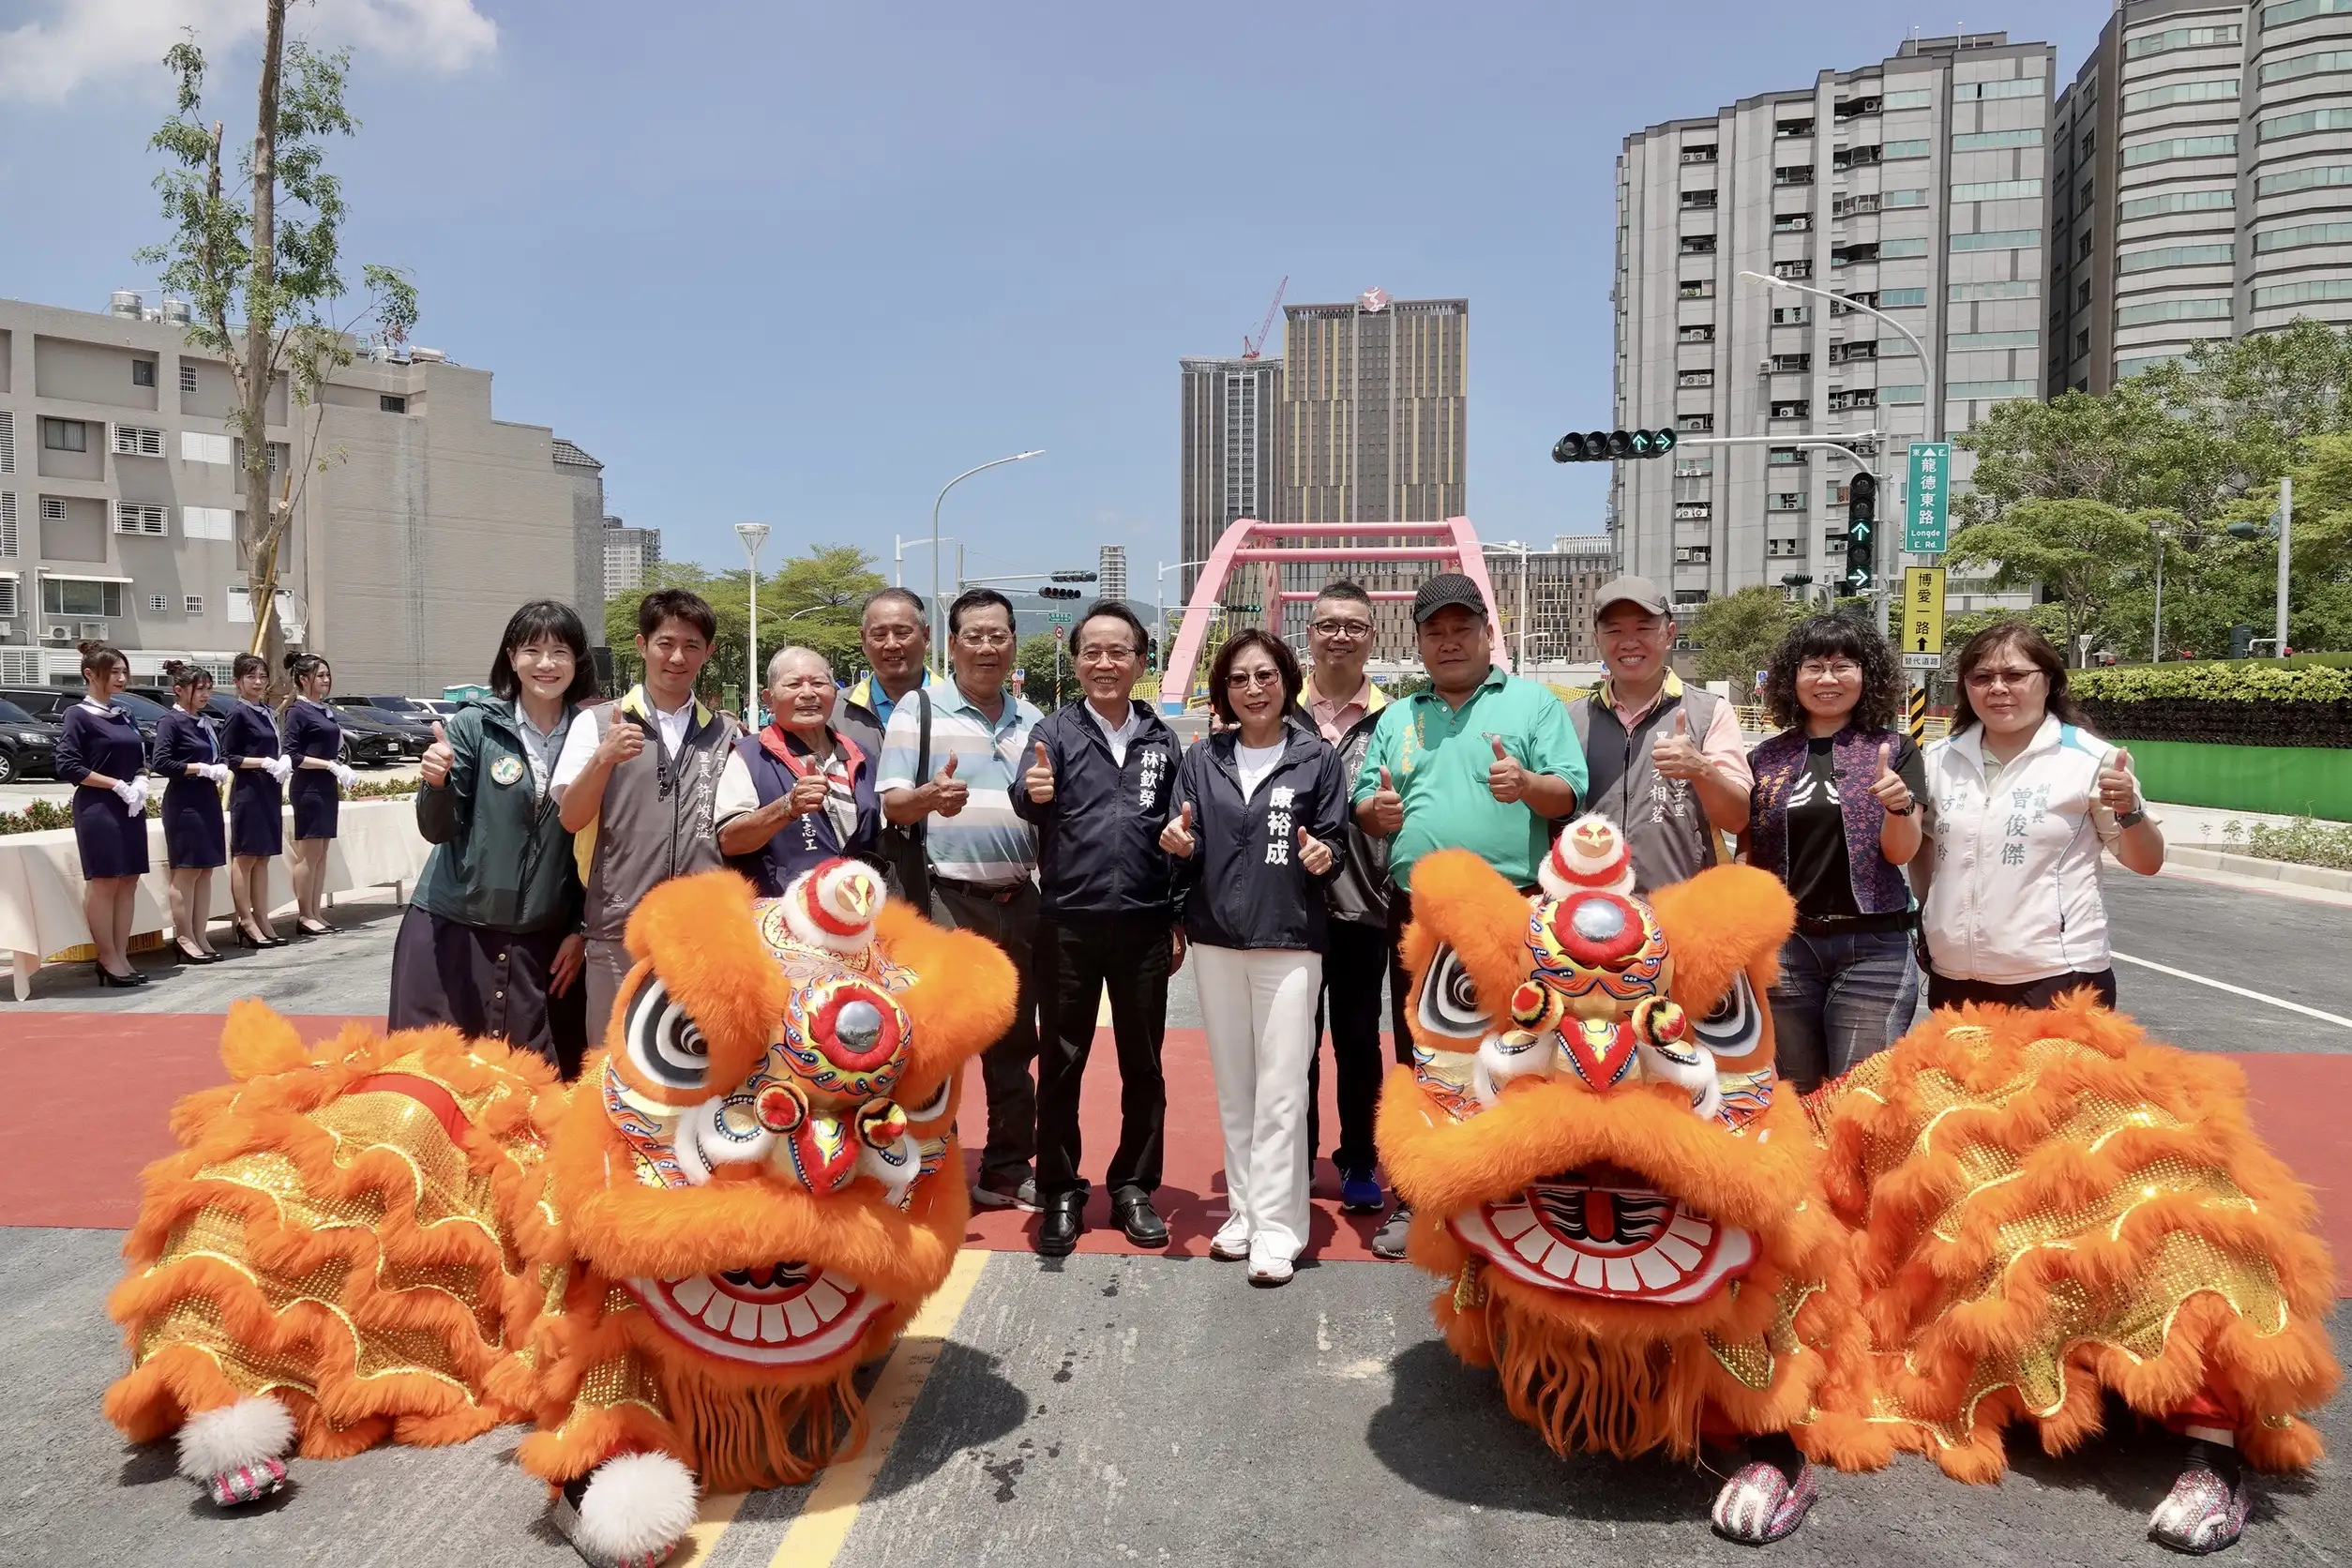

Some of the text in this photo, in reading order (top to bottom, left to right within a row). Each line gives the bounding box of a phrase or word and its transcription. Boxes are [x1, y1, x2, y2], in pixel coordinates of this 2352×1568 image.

[1912, 448, 1947, 457] 東 E.
[1919, 458, 1937, 525] 龍德東路
[1911, 529, 1940, 538] Longde
[1915, 572, 1932, 635] 博愛一路
[1905, 657, 1939, 666] 替代道路
[1138, 749, 1160, 809] 林欽榮
[2031, 783, 2051, 824] 副議長
[1264, 785, 1295, 866] 康裕成
[1999, 787, 2033, 867] 曾俊傑
